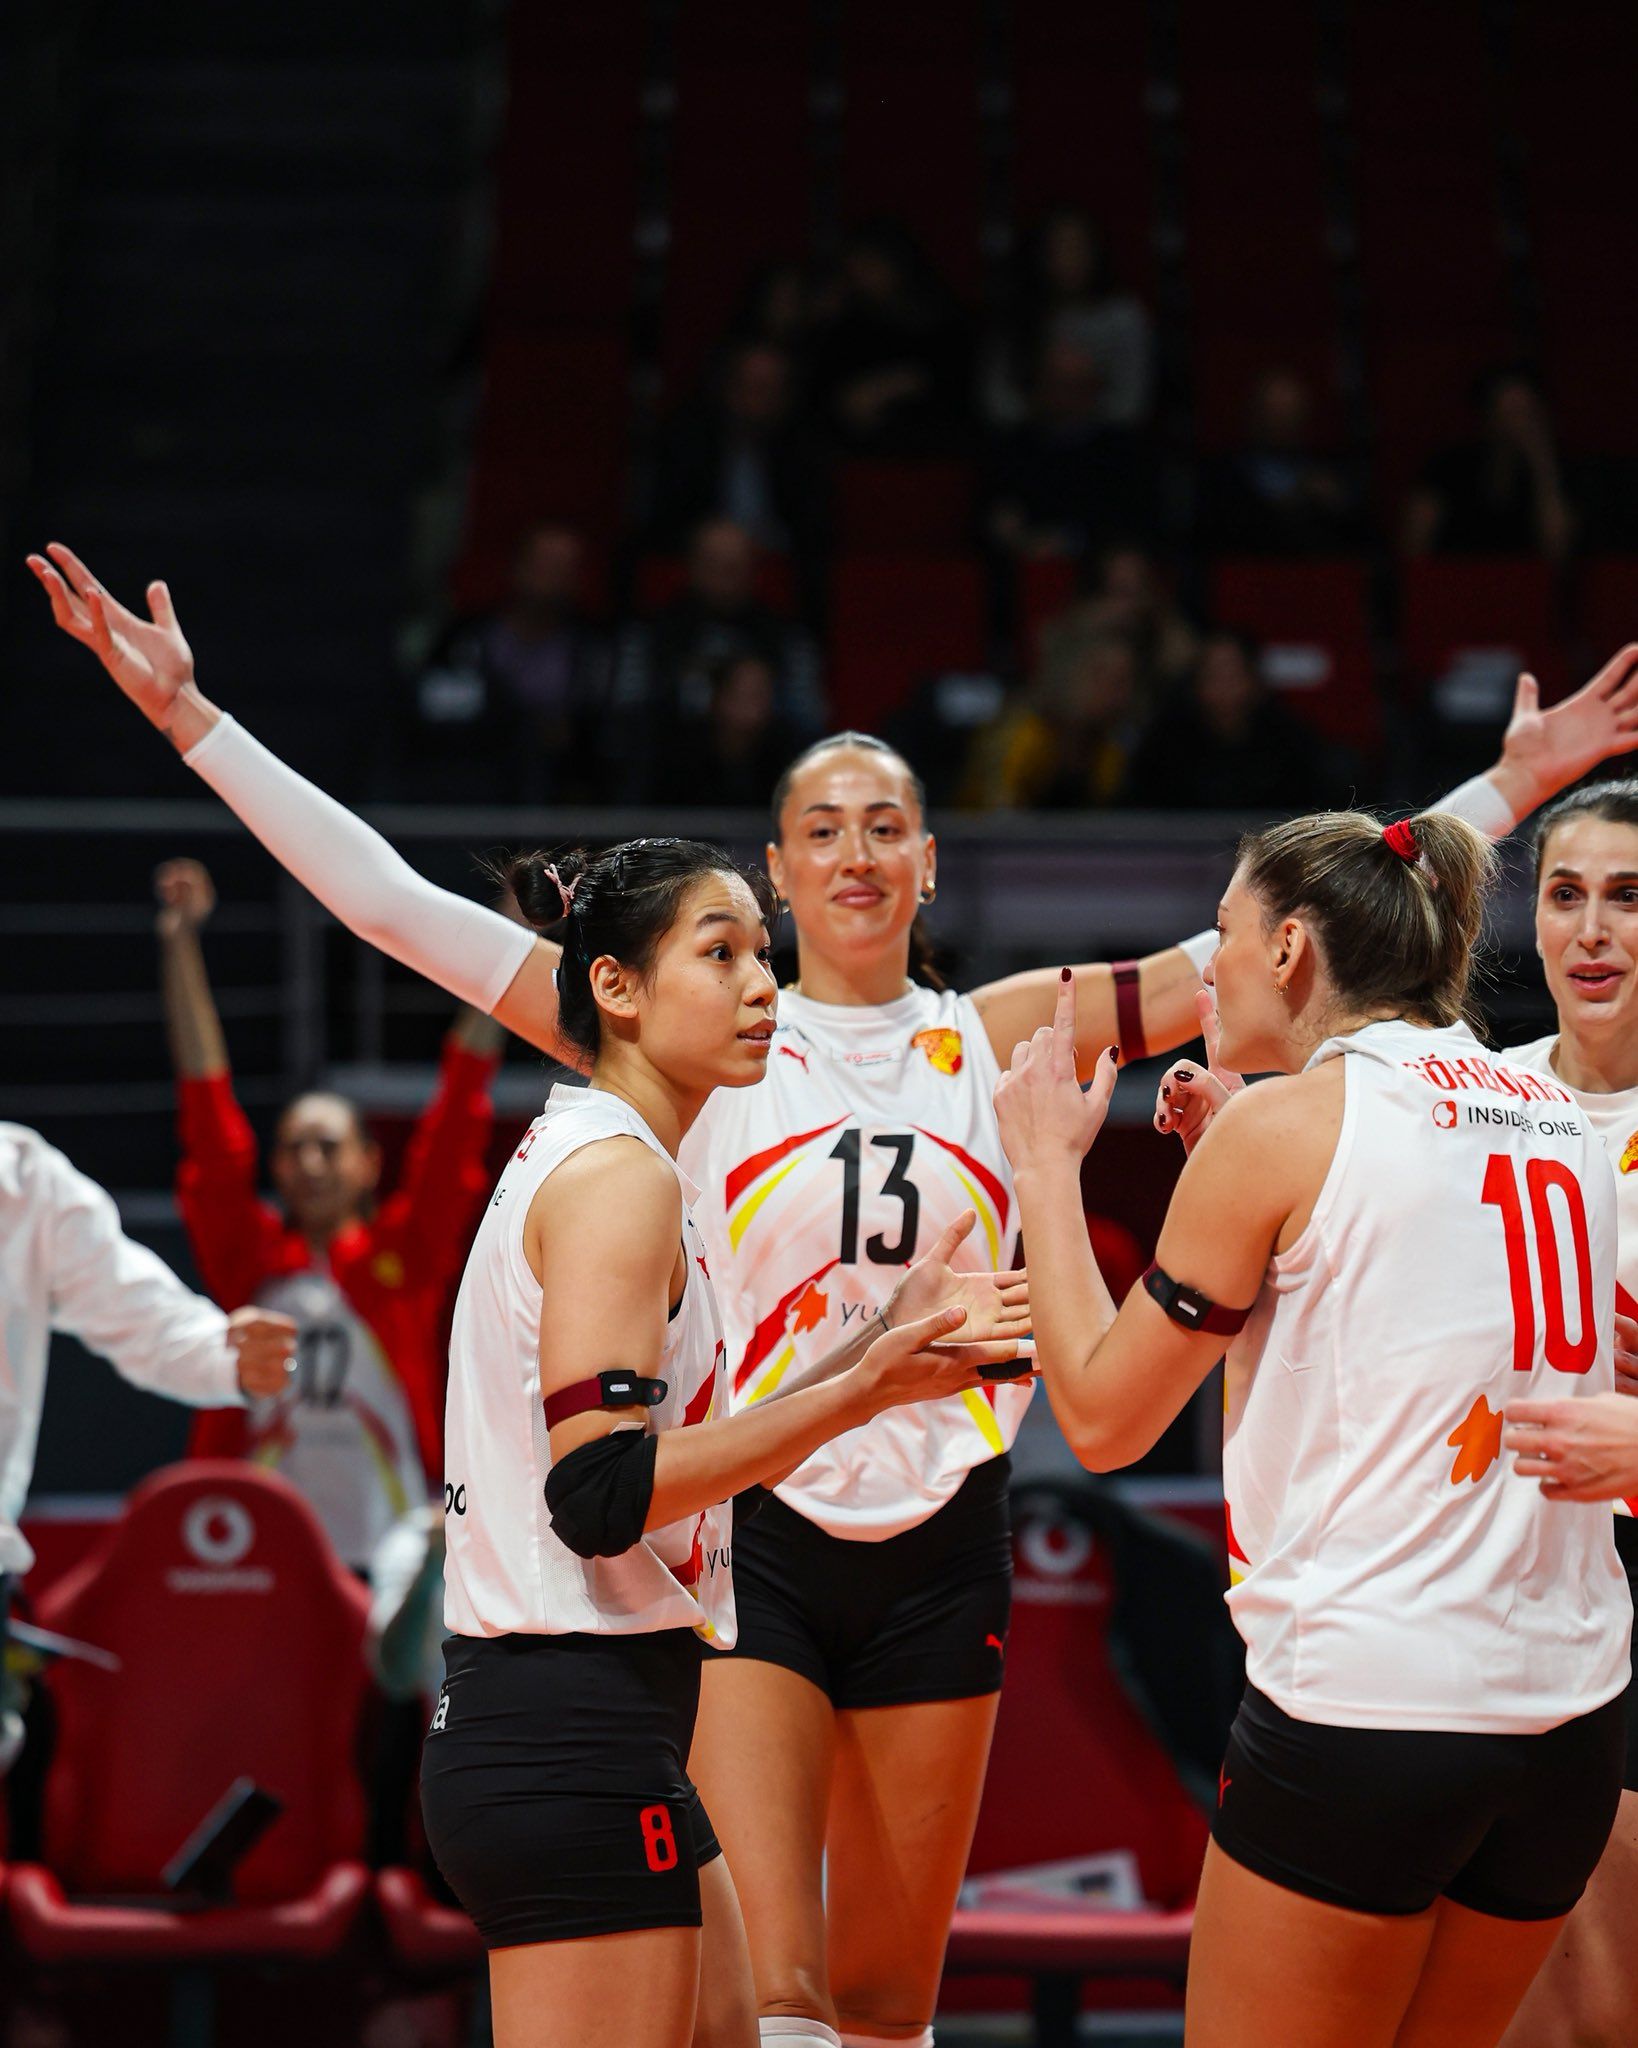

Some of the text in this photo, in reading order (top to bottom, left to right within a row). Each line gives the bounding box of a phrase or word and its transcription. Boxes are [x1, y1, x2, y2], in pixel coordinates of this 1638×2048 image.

[1468, 1106, 1582, 1136] INSIDER ONE
[828, 1128, 919, 1265] 13
[1481, 1153, 1598, 1375] 10
[640, 1803, 679, 1873] 8
